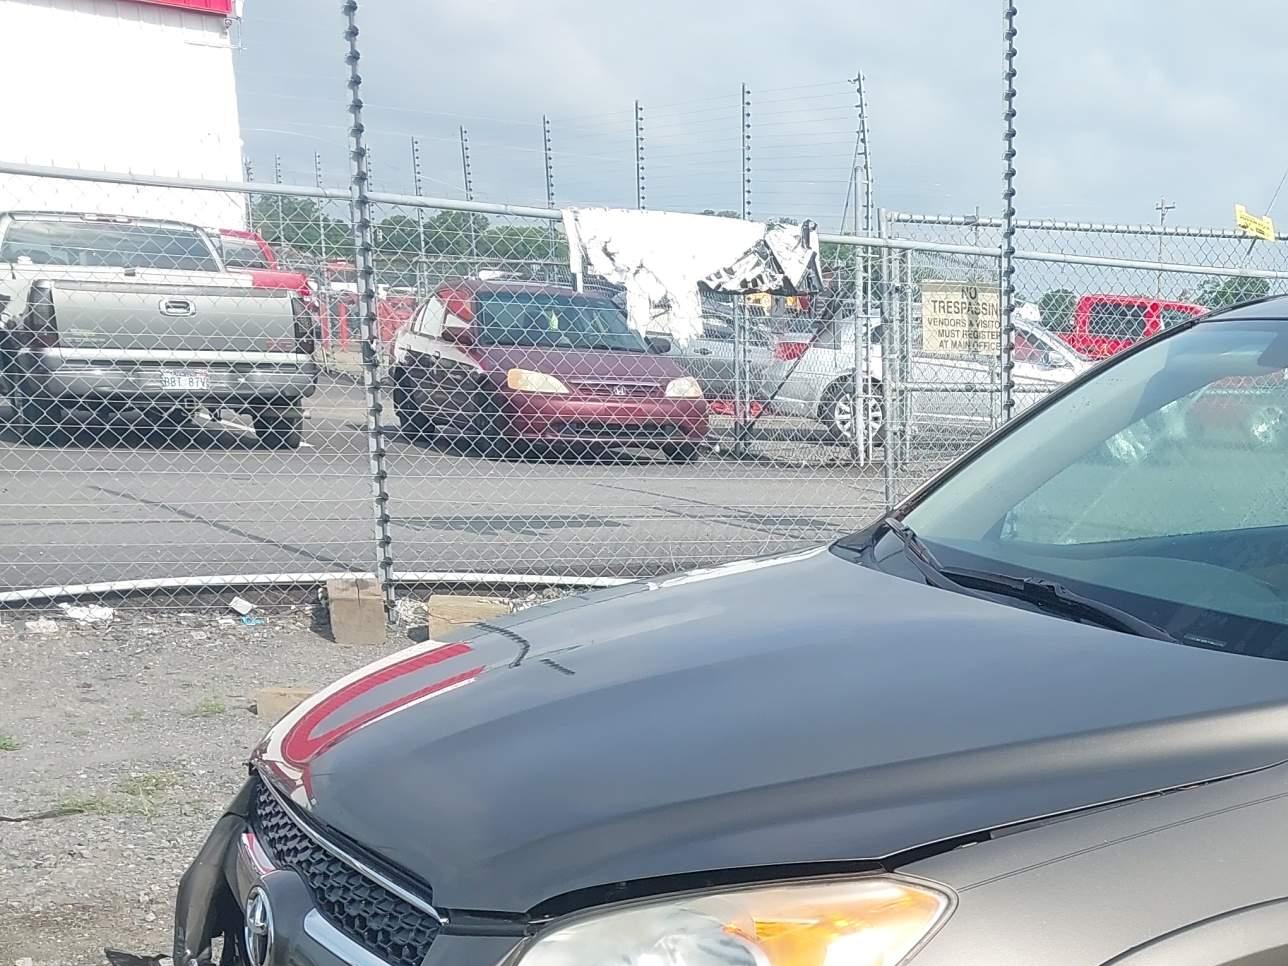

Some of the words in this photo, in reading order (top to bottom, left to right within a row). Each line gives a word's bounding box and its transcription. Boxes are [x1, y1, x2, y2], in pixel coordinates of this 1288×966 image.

[961, 286, 977, 300] NO
[931, 300, 999, 317] TRESPASSIN
[927, 317, 967, 328] VENDORS
[975, 319, 1000, 329] VISITO
[937, 329, 960, 338] MUST
[938, 340, 949, 349] AT
[950, 340, 970, 350] MAIN
